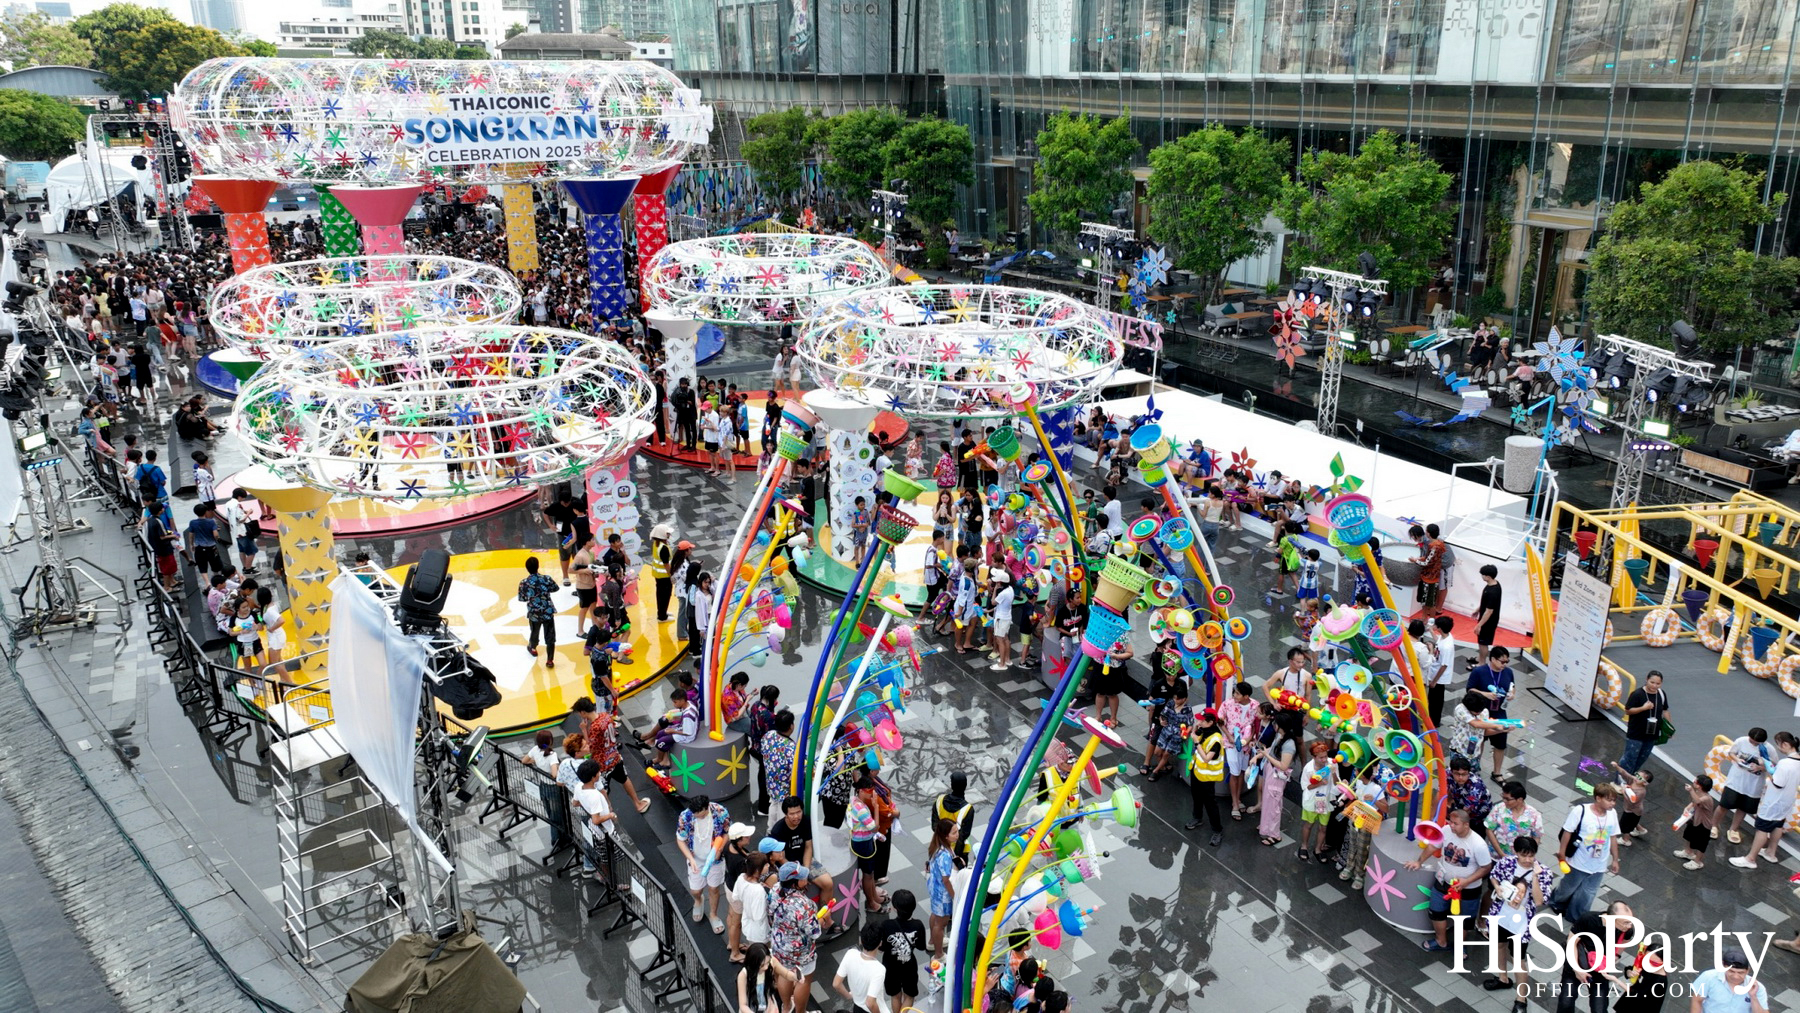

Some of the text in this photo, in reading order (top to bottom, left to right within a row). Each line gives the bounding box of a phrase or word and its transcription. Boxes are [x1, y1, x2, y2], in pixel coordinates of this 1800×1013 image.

[449, 96, 551, 111] THAICONIC
[404, 114, 598, 145] SONGKRAN
[428, 145, 582, 163] CELEBRATION 2025
[1306, 570, 1316, 579] 10
[1532, 572, 1543, 610] SINGHA
[1574, 580, 1596, 597] Kid Zone
[1721, 625, 1739, 657] SINGHA
